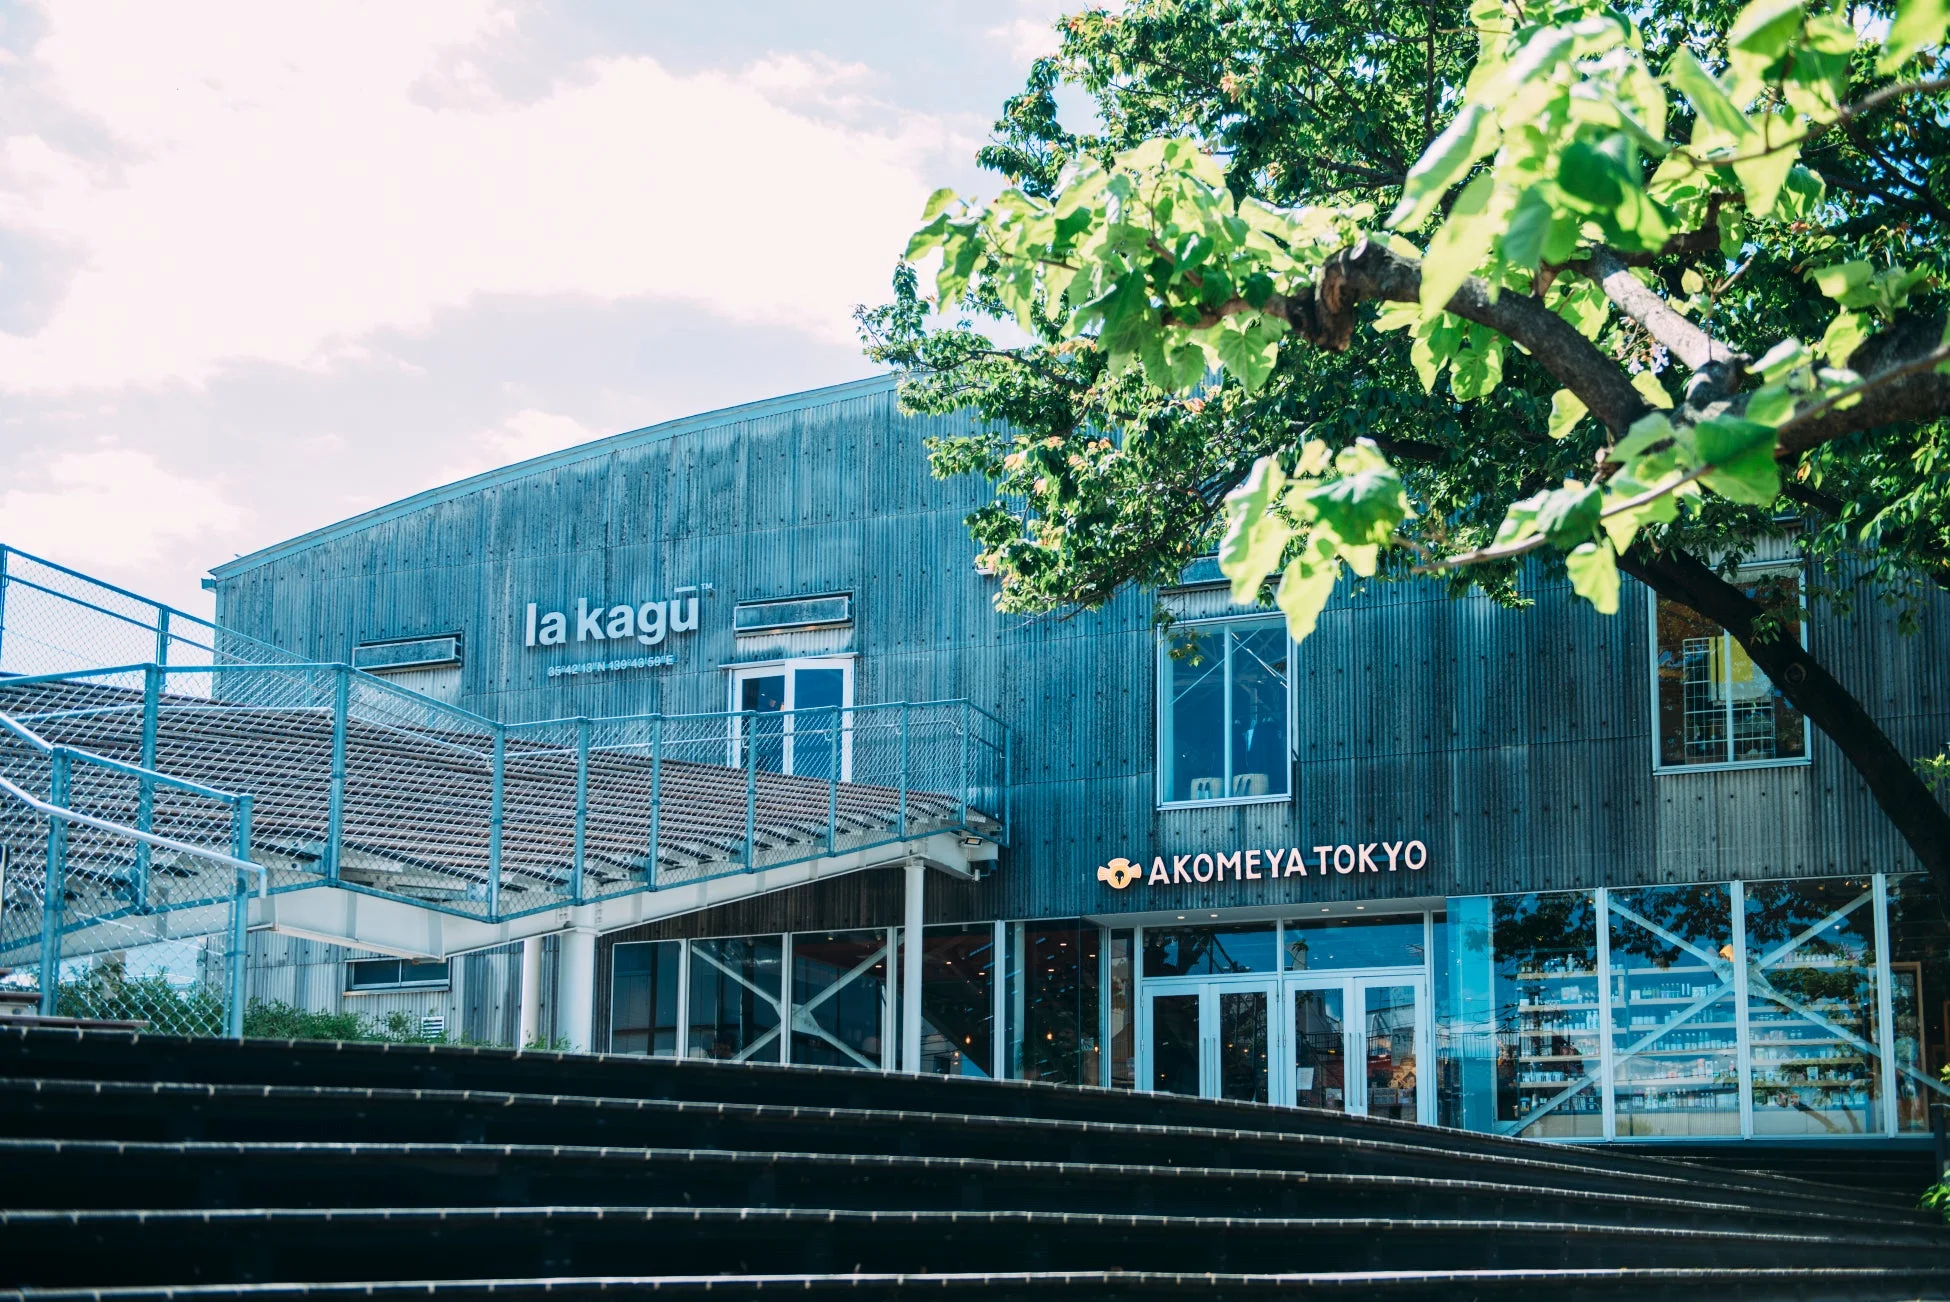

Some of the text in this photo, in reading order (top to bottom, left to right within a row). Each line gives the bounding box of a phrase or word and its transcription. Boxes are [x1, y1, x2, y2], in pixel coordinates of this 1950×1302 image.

[526, 602, 566, 647] la
[1147, 840, 1427, 885] AKOMEYA TOKYO
